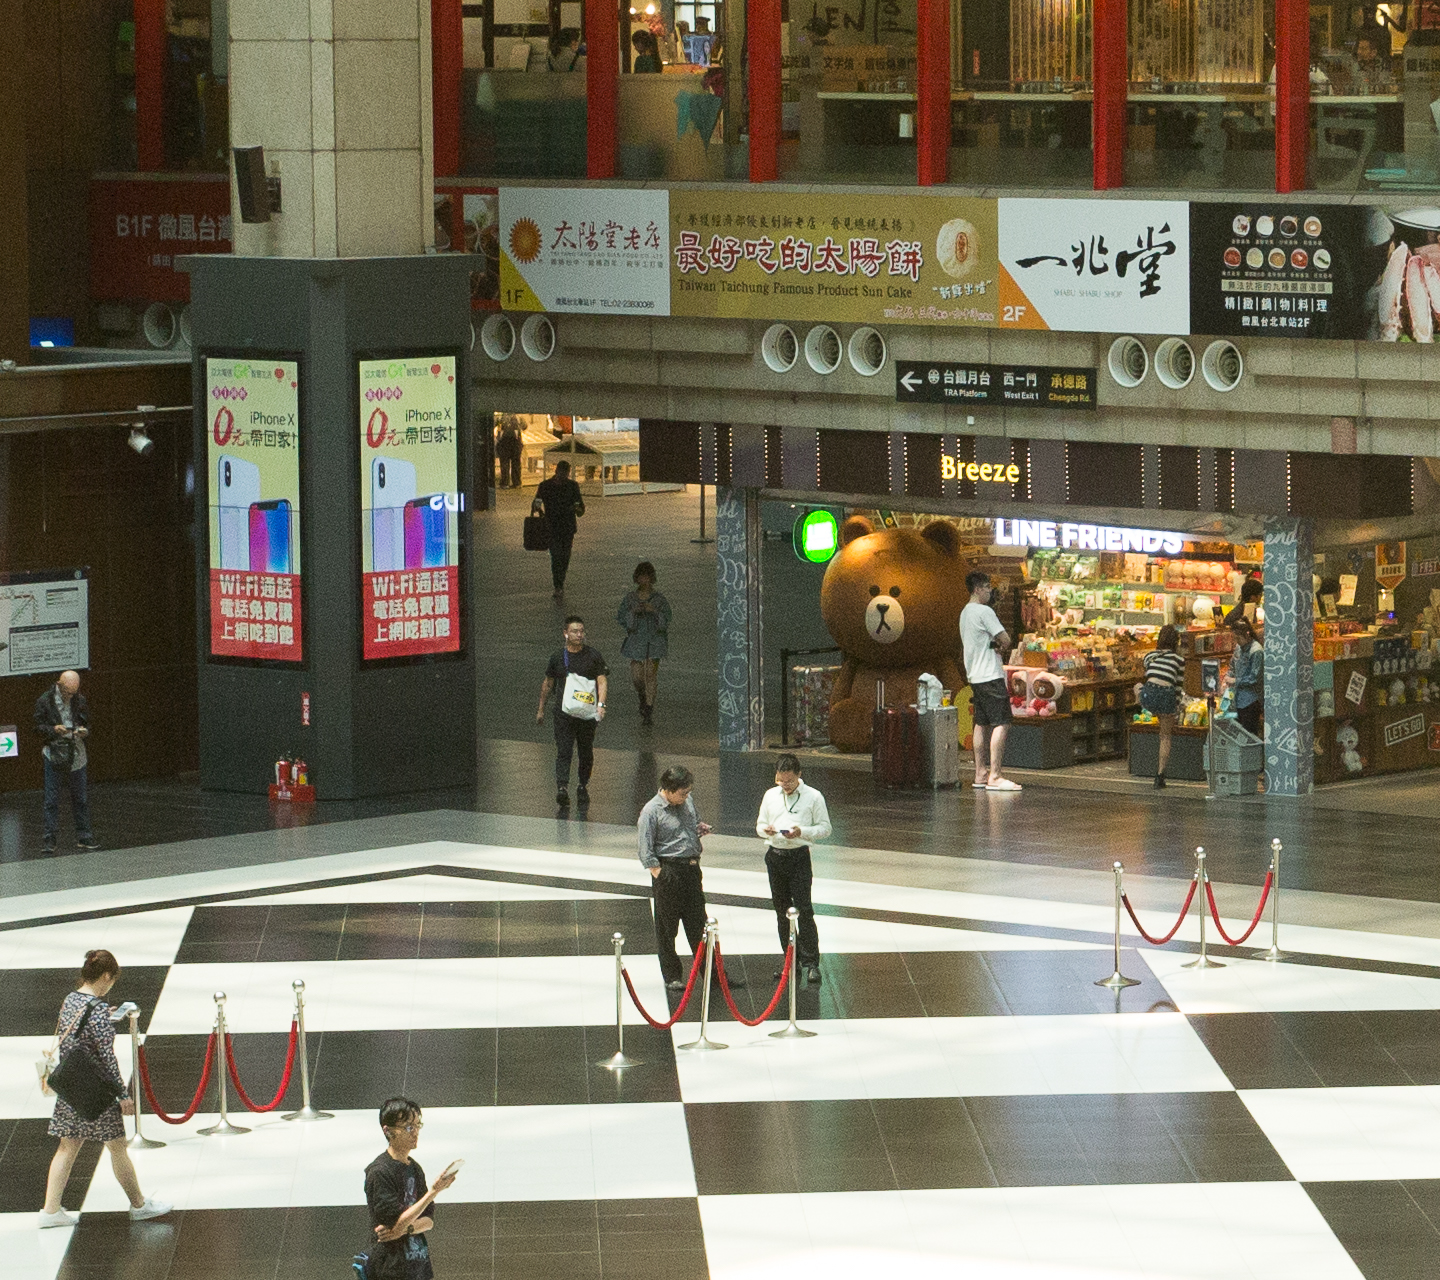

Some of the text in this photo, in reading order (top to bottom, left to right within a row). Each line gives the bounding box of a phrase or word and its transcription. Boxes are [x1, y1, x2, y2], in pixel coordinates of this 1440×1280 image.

[116, 214, 153, 237] B1F
[550, 220, 661, 251] 太陽堂老店
[674, 230, 923, 282] 最好吃的太陽餅
[1015, 221, 1177, 299] 一兆堂
[505, 289, 524, 304] 1F
[678, 279, 912, 299] Taiwan Taichung Famous Product Sun Cake
[1053, 289, 1076, 297] SHABU
[1104, 290, 1123, 298] SHOP
[1003, 305, 1026, 322] 2F
[943, 370, 1087, 390] 台鐵月台 西一門 承德路
[944, 388, 958, 397] TRA
[958, 389, 988, 398] Platform
[1004, 391, 1020, 399] West
[1021, 391, 1035, 400] Exit
[249, 410, 295, 426] iPhone X
[405, 406, 453, 423] iPhone X
[250, 429, 297, 450] 帶回家!
[405, 425, 453, 445] 帶回家!
[941, 454, 1021, 484] Breeze
[996, 517, 1058, 548] LINE
[1062, 522, 1185, 555] FRIENDS
